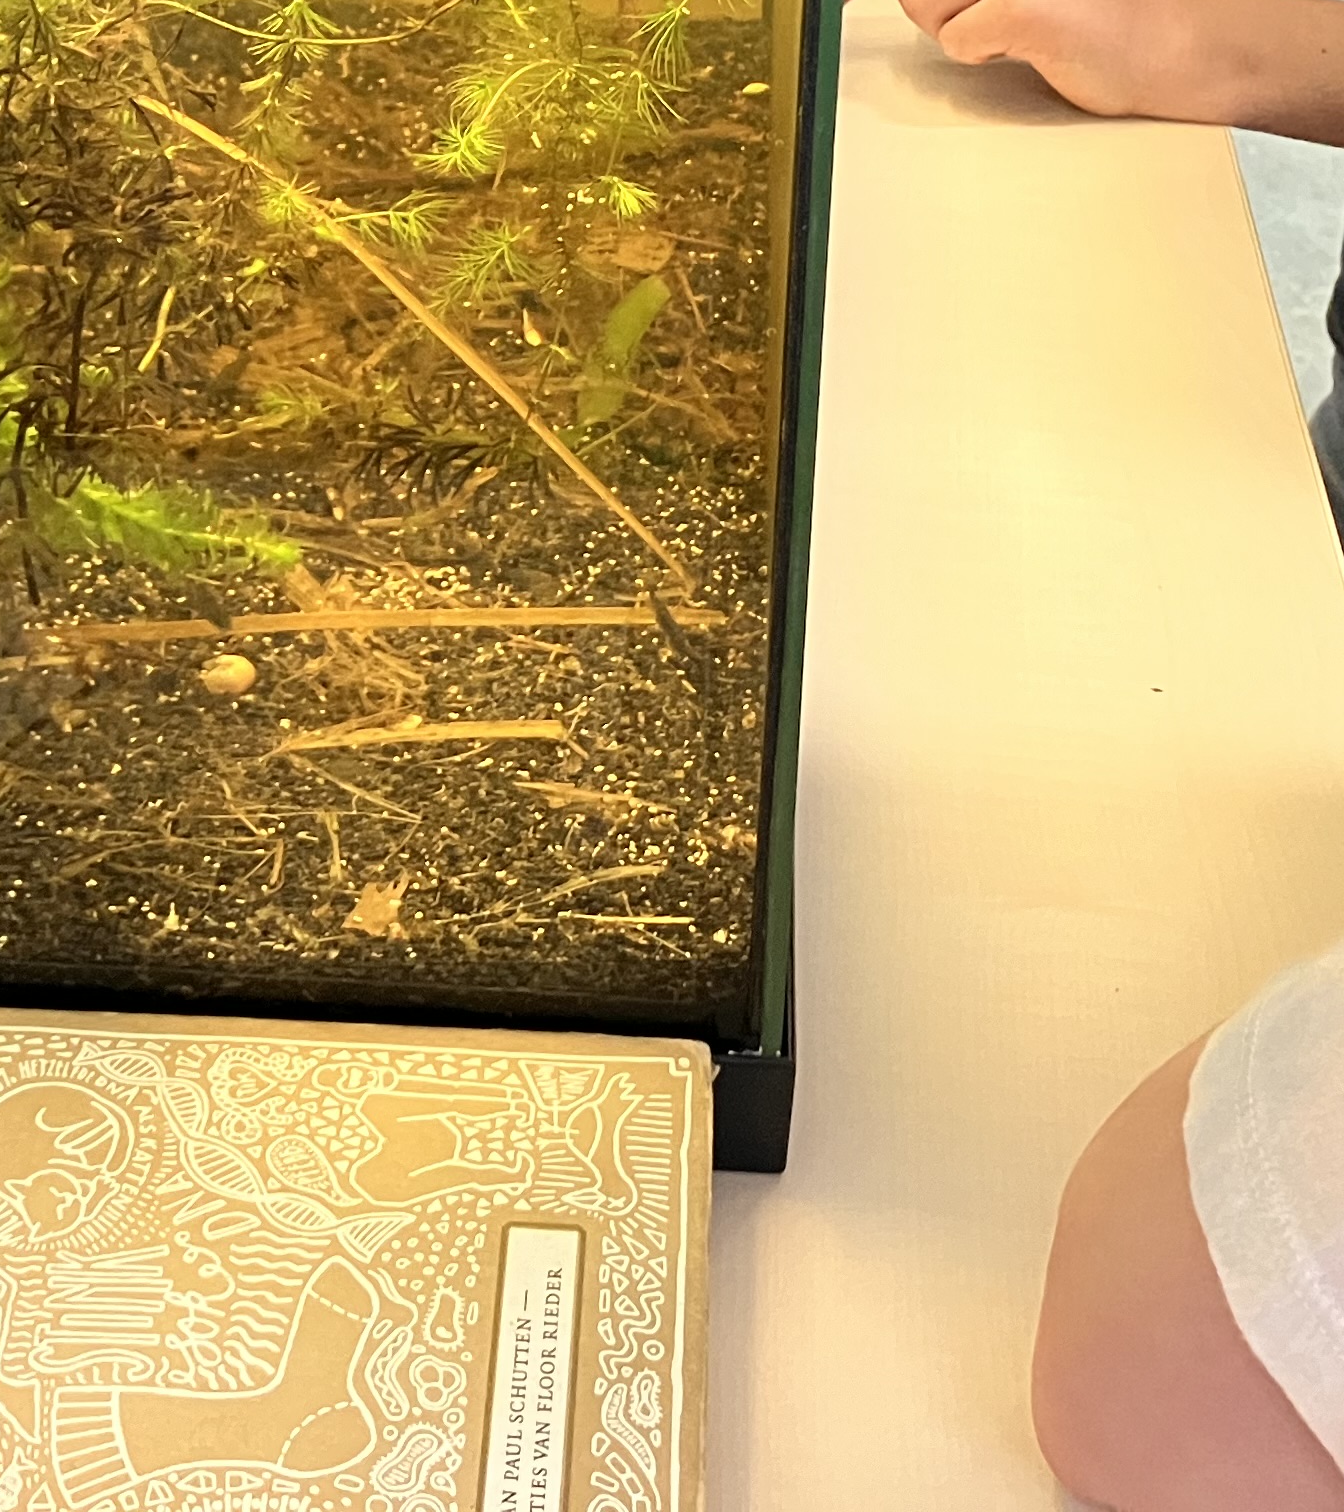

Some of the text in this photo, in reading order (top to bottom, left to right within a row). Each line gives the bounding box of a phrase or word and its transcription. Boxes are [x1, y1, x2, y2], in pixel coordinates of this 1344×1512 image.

[95, 1076, 140, 1106] DNA
[110, 1137, 157, 1212] KATTEN
[156, 1170, 261, 1241] DNA
[28, 1244, 173, 1382] STINK
[542, 1267, 563, 1340] RIEDER
[509, 1317, 532, 1424] SCHUTTEN
[537, 1346, 556, 1412] FLOOR
[504, 1429, 522, 1481] PAUL
[533, 1421, 551, 1461] VAN
